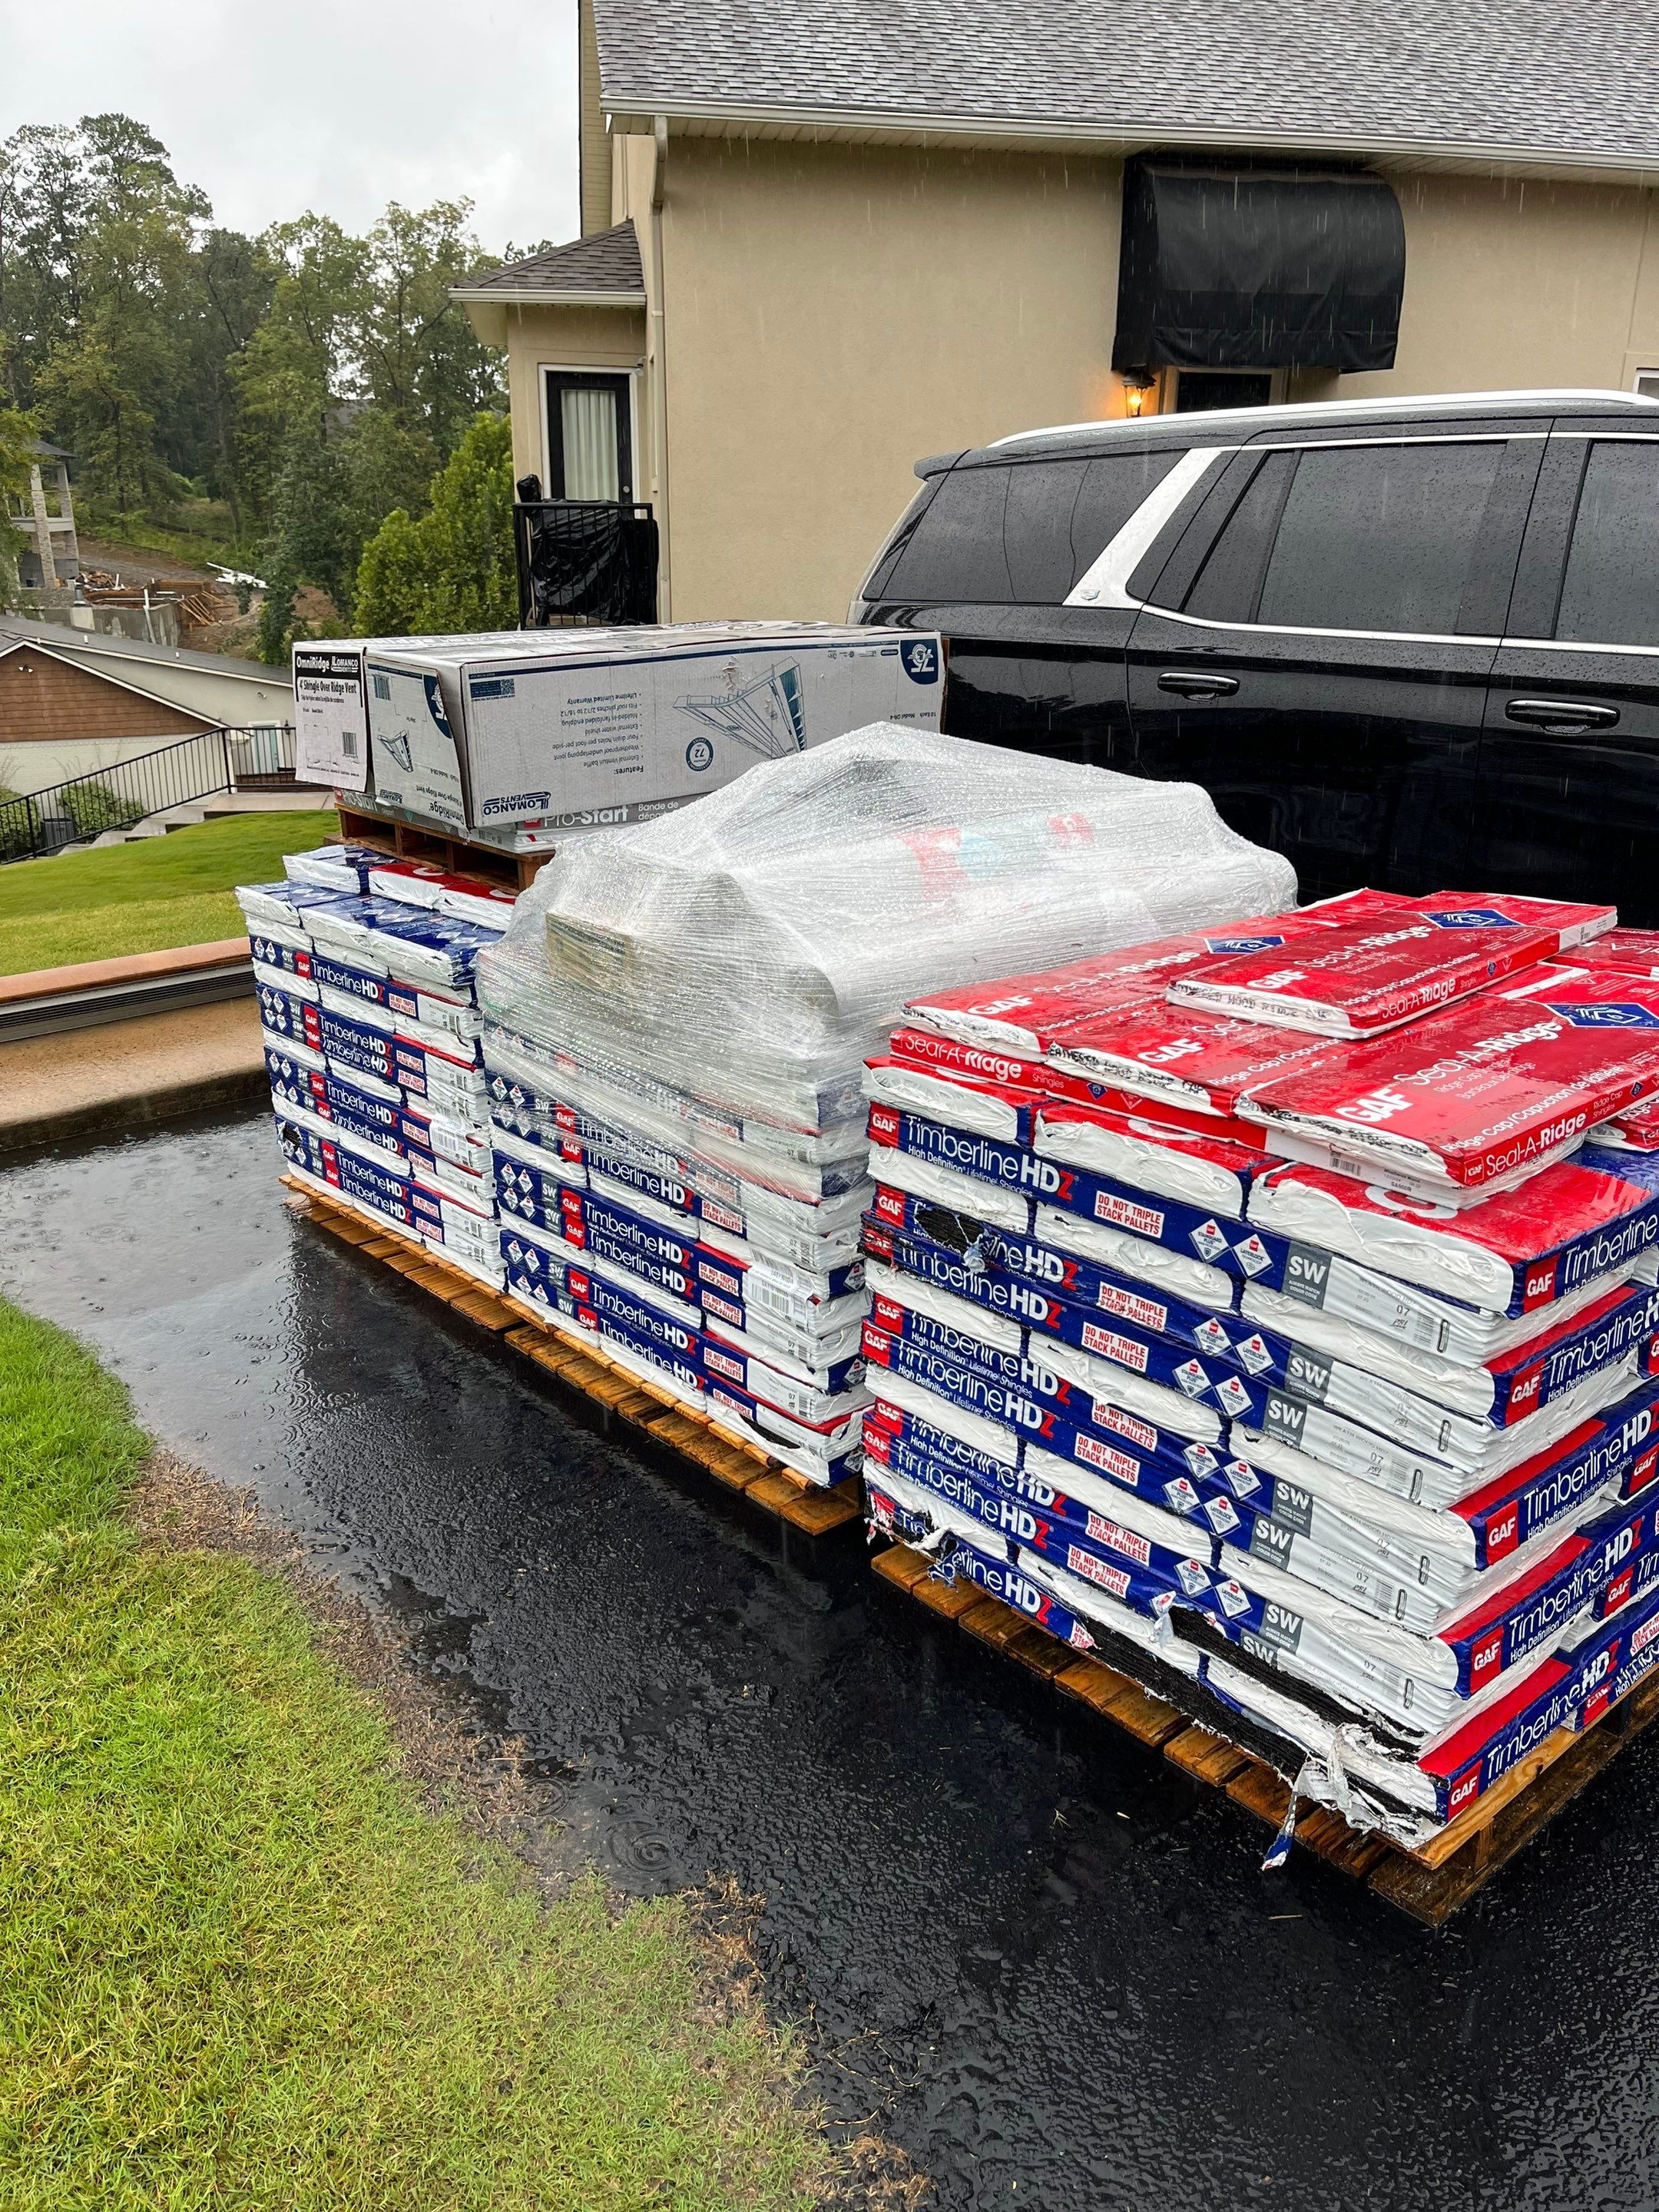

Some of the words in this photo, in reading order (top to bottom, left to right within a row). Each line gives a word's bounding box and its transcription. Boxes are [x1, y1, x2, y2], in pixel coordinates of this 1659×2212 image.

[297, 655, 329, 673] OmniRidge
[320, 680, 330, 693] Over
[331, 680, 344, 696] Ridge
[344, 682, 357, 694] Vent
[614, 692, 637, 701] Lifetime
[567, 697, 593, 707] Warranty
[593, 695, 614, 704] Limited
[597, 704, 617, 714] pitches
[560, 709, 576, 717] 16/12
[561, 717, 584, 728] endplug
[584, 727, 601, 737] shield
[617, 723, 638, 731] External
[597, 737, 612, 745] holes
[604, 744, 639, 755] Weatherproof
[553, 752, 568, 761] joint
[567, 748, 604, 760] underlapping
[618, 754, 640, 763] External
[694, 748, 705, 759] 72
[613, 766, 644, 777] Features:
[483, 798, 549, 817] LOMANCO
[501, 793, 526, 805] VENTS
[545, 805, 628, 827] Pro-Start
[638, 803, 666, 812] Bande
[667, 800, 679, 810] de
[298, 961, 310, 972] GAF
[1246, 969, 1310, 989] GAF
[1293, 924, 1433, 969] Seal-A-Ridge
[967, 994, 1035, 1015] GAF
[1032, 952, 1200, 994] Seal-A-Ridge
[1376, 976, 1456, 1020] Seal-A-Ridge
[305, 1014, 317, 1026] GAF
[905, 1034, 1022, 1081] Seal-A-Ridge
[1137, 1037, 1206, 1063] GAF
[1031, 1073, 1065, 1089] Shingles
[1206, 1068, 1252, 1088] Ridge
[1334, 1088, 1414, 1123] GAF
[1392, 1020, 1564, 1086] Seal-A-Ridge
[313, 1081, 325, 1091] GAF
[1593, 1094, 1610, 1111] Ridge
[1609, 1090, 1624, 1103] Cap
[318, 1107, 331, 1118] GAF
[556, 1111, 575, 1127] GAF
[1439, 1134, 1481, 1154] Ridge
[1481, 1086, 1571, 1136] Cap/Capuchon
[1569, 1078, 1584, 1092] de
[873, 1113, 897, 1133] GAF
[563, 1140, 581, 1157] GAF
[908, 1144, 926, 1162] High
[1468, 1164, 1483, 1177] GAF
[1485, 1112, 1587, 1177] Seal-A-Ridge
[323, 1149, 336, 1161] GAF
[326, 1169, 338, 1181] GAF
[542, 1182, 558, 1199] SW
[562, 1197, 580, 1212] GAF
[879, 1195, 902, 1217] GAF
[1098, 1194, 1110, 1206] DO
[1112, 1198, 1128, 1213] NOT
[1131, 1205, 1161, 1225] TRIPLE
[1097, 1204, 1123, 1223] STACK
[1124, 1213, 1160, 1236] PALLETS
[566, 1224, 583, 1238] GAF
[1527, 1272, 1554, 1297] GAF
[1565, 1214, 1658, 1284] Timberline
[700, 1263, 708, 1273] DO
[709, 1267, 719, 1278] NOT
[720, 1272, 738, 1287] TRIPLE
[1288, 1255, 1326, 1285] SW
[570, 1278, 587, 1293] GAF
[700, 1270, 716, 1283] STACK
[716, 1277, 738, 1294] PALLETS
[558, 1298, 573, 1315] SW
[579, 1313, 597, 1328] GAF
[876, 1301, 900, 1320] GAF
[1396, 1304, 1410, 1316] 07
[864, 1330, 889, 1352] GAF
[1084, 1325, 1096, 1336] DO
[1098, 1330, 1115, 1344] NOT
[1118, 1337, 1146, 1358] TRIPLE
[704, 1349, 713, 1357] DO
[714, 1352, 724, 1363] NOT
[724, 1357, 742, 1373] TRIPLE
[1084, 1335, 1108, 1353] STACK
[1110, 1346, 1144, 1369] PALLETS
[704, 1356, 720, 1369] STACK
[720, 1363, 742, 1380] PALLETS
[911, 1331, 929, 1349] High
[1000, 1375, 1033, 1399] Shingles
[1289, 1357, 1329, 1389] SW
[898, 1363, 916, 1381] High
[984, 1409, 1016, 1434] Shingles
[1511, 1375, 1540, 1404] GAF
[1548, 1384, 1565, 1402] High
[877, 1402, 900, 1422] GAF
[1268, 1399, 1303, 1429] SW
[865, 1431, 887, 1451] GAF
[1078, 1435, 1089, 1447] DO
[1091, 1441, 1108, 1455] NOT
[1110, 1449, 1137, 1472] TRIPLE
[1370, 1452, 1384, 1464] 07
[1076, 1445, 1101, 1466] STACK
[1102, 1458, 1136, 1483] PALLETS
[1634, 1451, 1657, 1477] GAF
[1277, 1482, 1310, 1510] SW
[1527, 1524, 1544, 1541] High
[1606, 1453, 1633, 1481] Shingles
[1256, 1520, 1290, 1550] SW
[1488, 1516, 1516, 1547] GAF
[1257, 1547, 1271, 1558] COLOR
[1271, 1553, 1283, 1563] CODE
[1356, 1571, 1369, 1583] 07
[1608, 1576, 1631, 1603] GAF
[1267, 1604, 1301, 1634] SW
[1510, 1642, 1527, 1664] High
[1588, 1572, 1614, 1601] Shingles
[1265, 1632, 1279, 1642] COLOR
[1473, 1641, 1501, 1671] GAF
[1450, 1776, 1478, 1806] GAF
